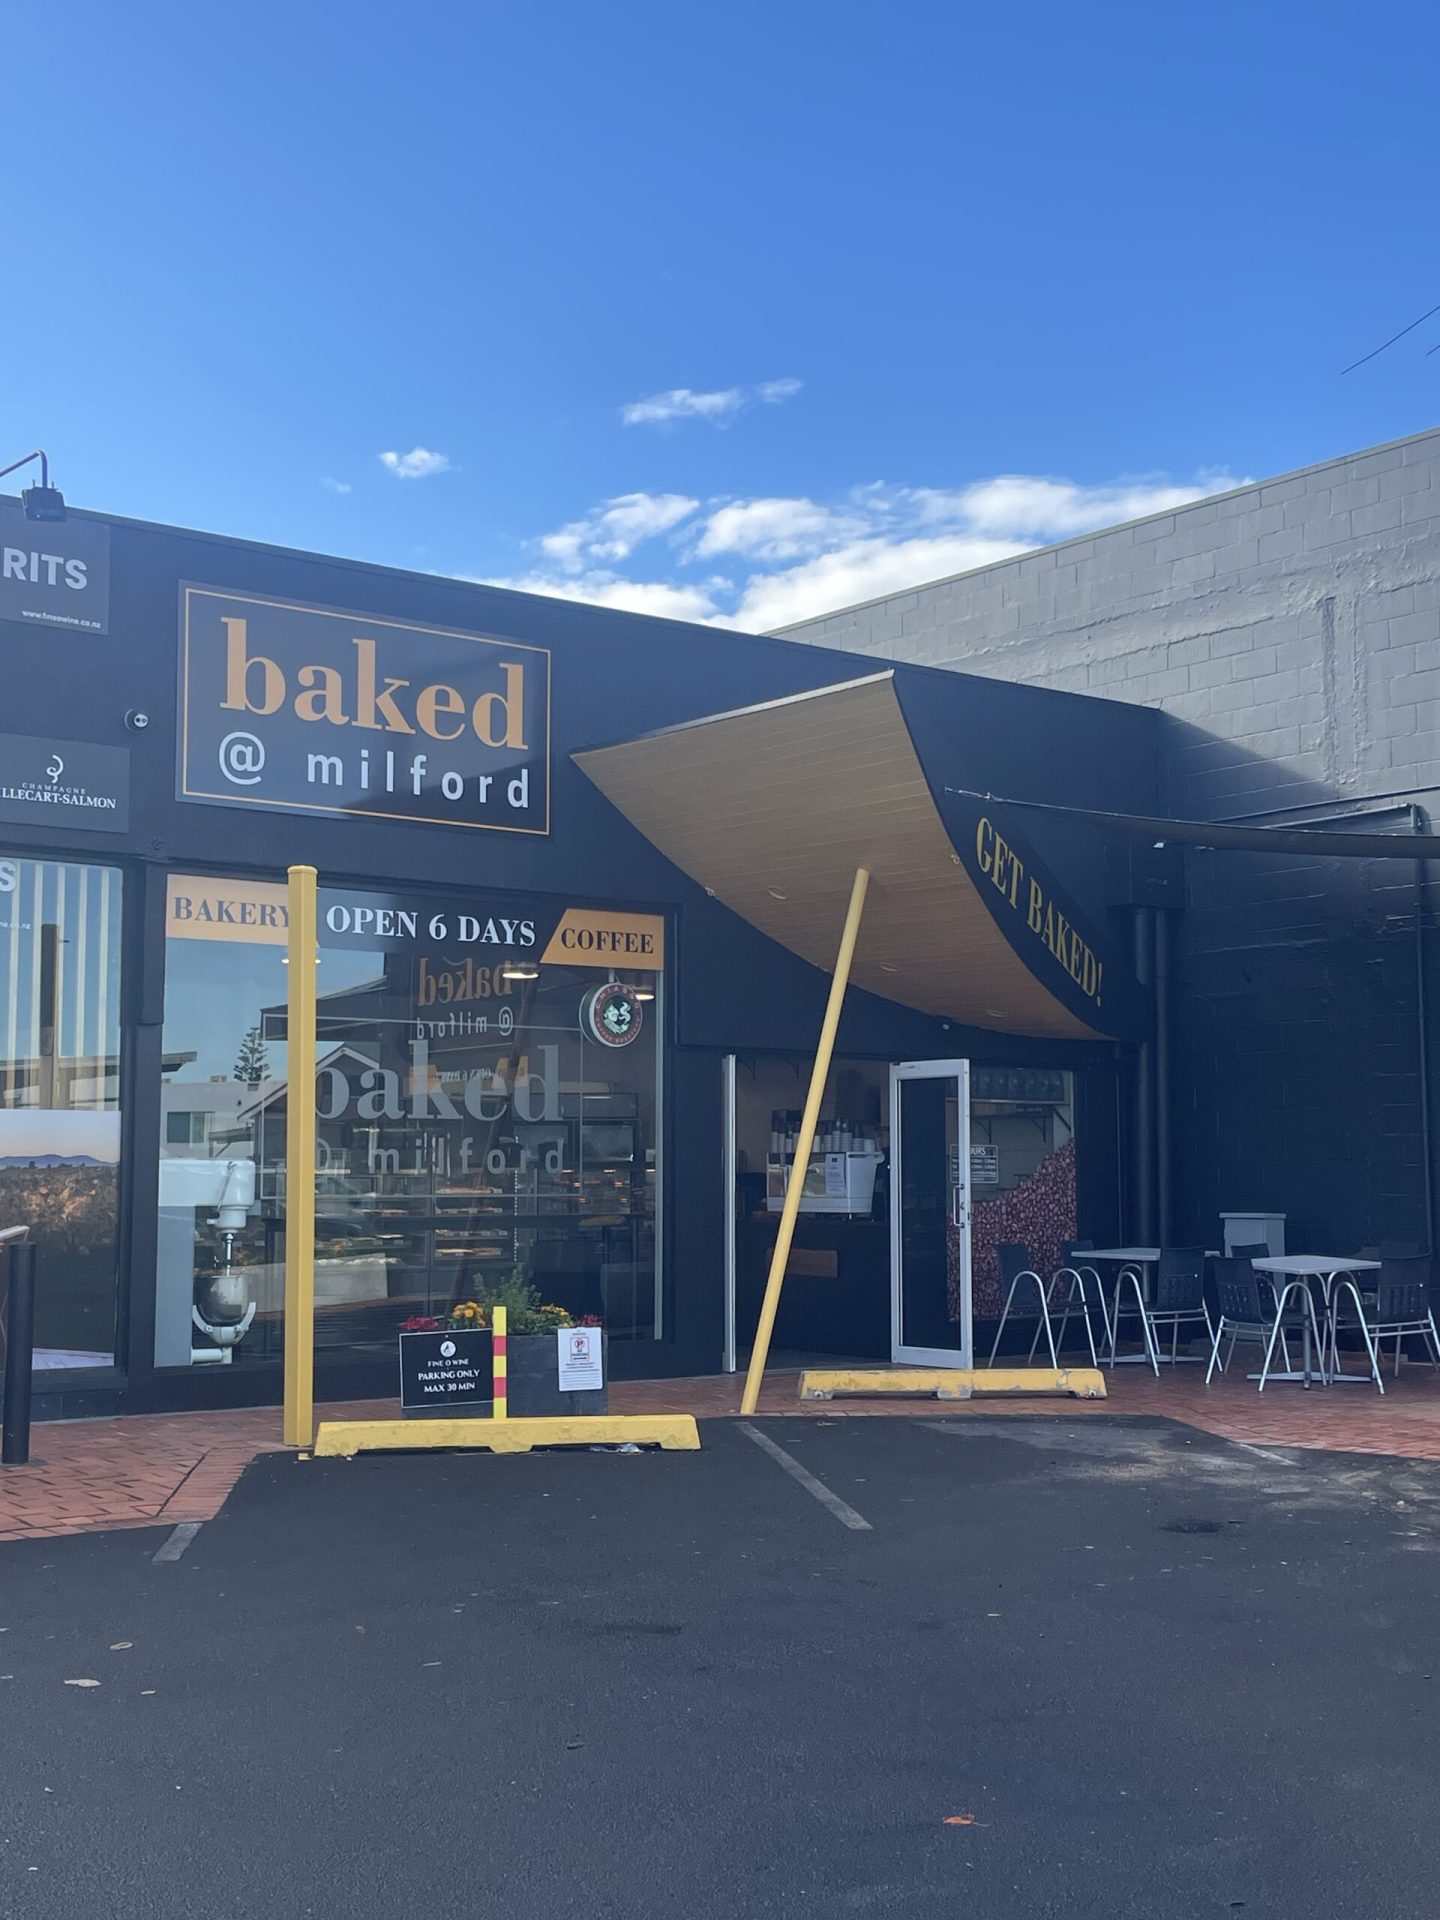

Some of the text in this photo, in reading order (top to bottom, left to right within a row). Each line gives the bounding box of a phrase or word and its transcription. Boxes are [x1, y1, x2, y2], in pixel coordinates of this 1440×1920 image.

[3, 547, 88, 590] RITS
[220, 616, 529, 750] baked
[218, 731, 529, 809] @ milford
[0, 786, 117, 809] LLECART-SALMON
[22, 782, 86, 795] CHAMPAGNE
[976, 817, 1103, 1008] GET BAKED!
[326, 905, 418, 938] OPEN
[428, 913, 448, 940] 6
[457, 915, 536, 947] DAYS
[560, 927, 655, 955] COFFEE
[418, 1369, 480, 1381] PARKING ONLY
[452, 1358, 469, 1366] WINE
[424, 1382, 476, 1393] MAX 30 MIN
